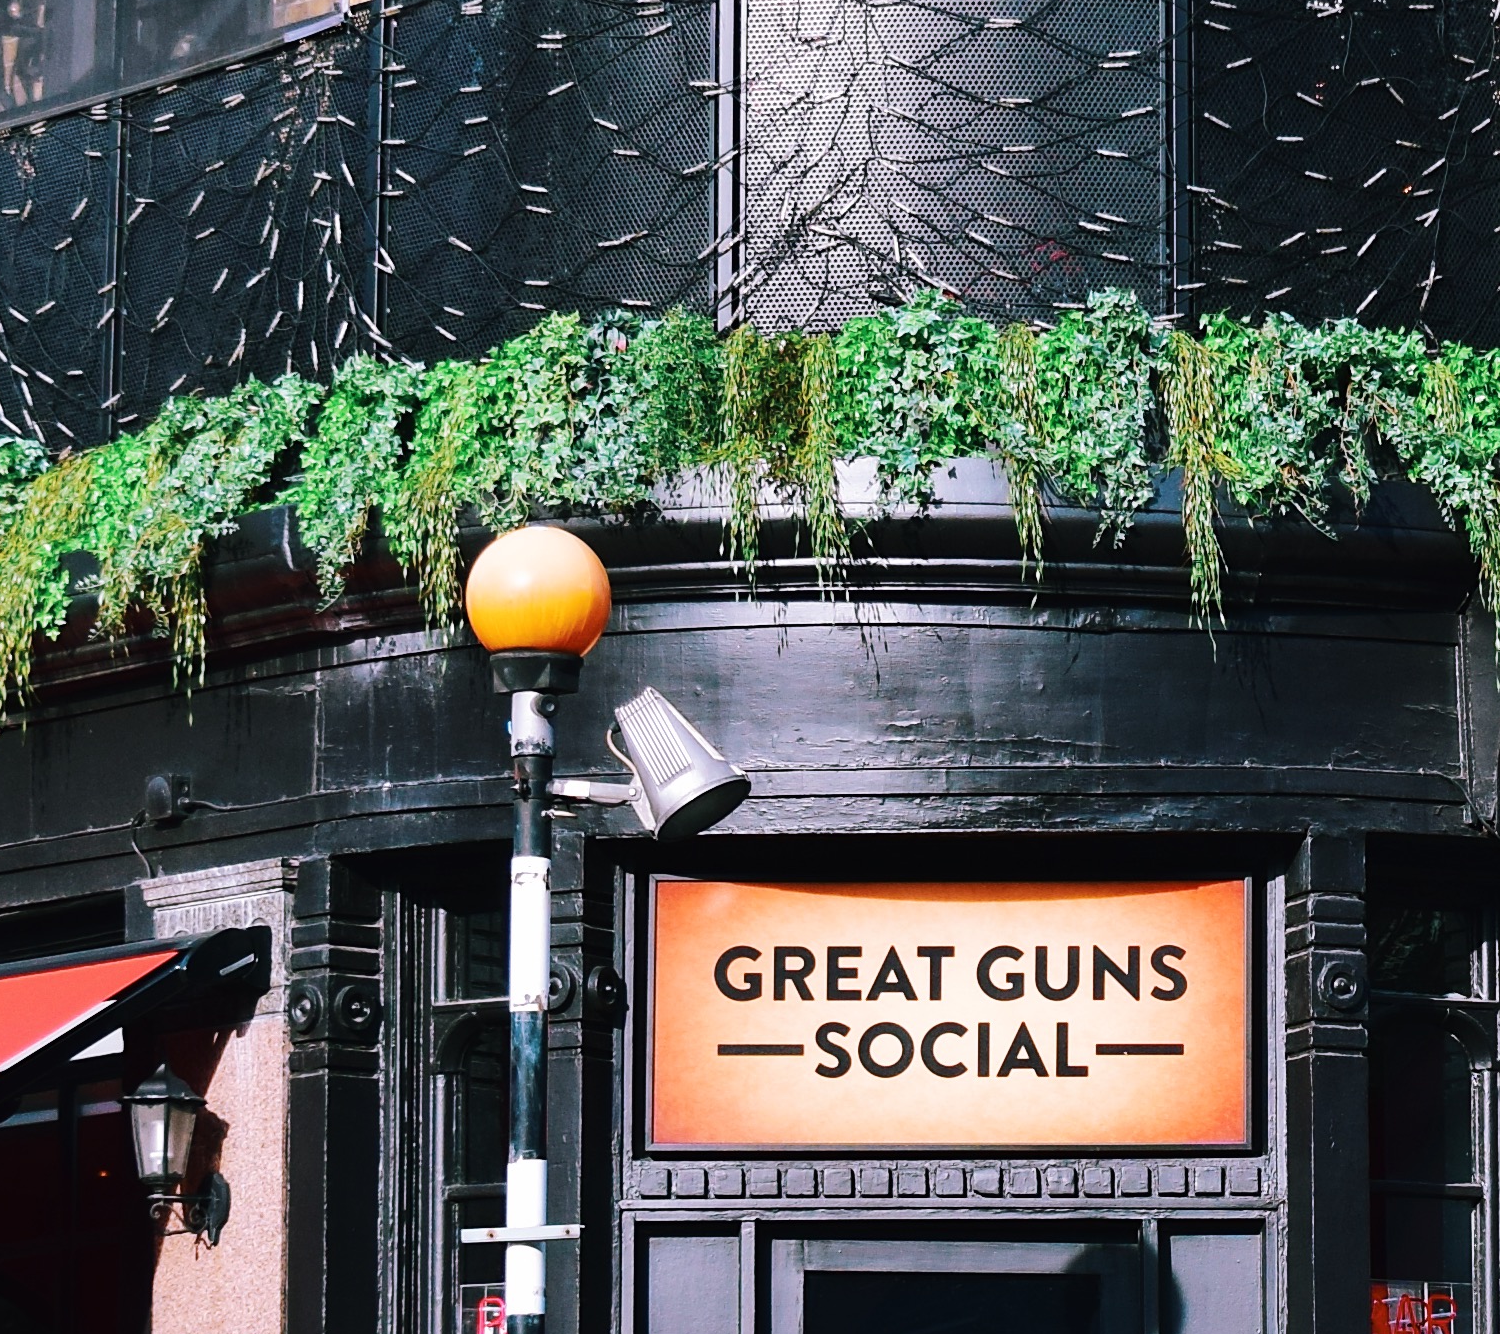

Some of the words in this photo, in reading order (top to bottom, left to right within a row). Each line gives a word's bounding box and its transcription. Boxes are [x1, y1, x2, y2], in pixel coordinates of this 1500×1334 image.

[713, 944, 956, 1002] GREAT
[975, 943, 1189, 1002] GUNS
[814, 1020, 1089, 1079] SOCIAL
